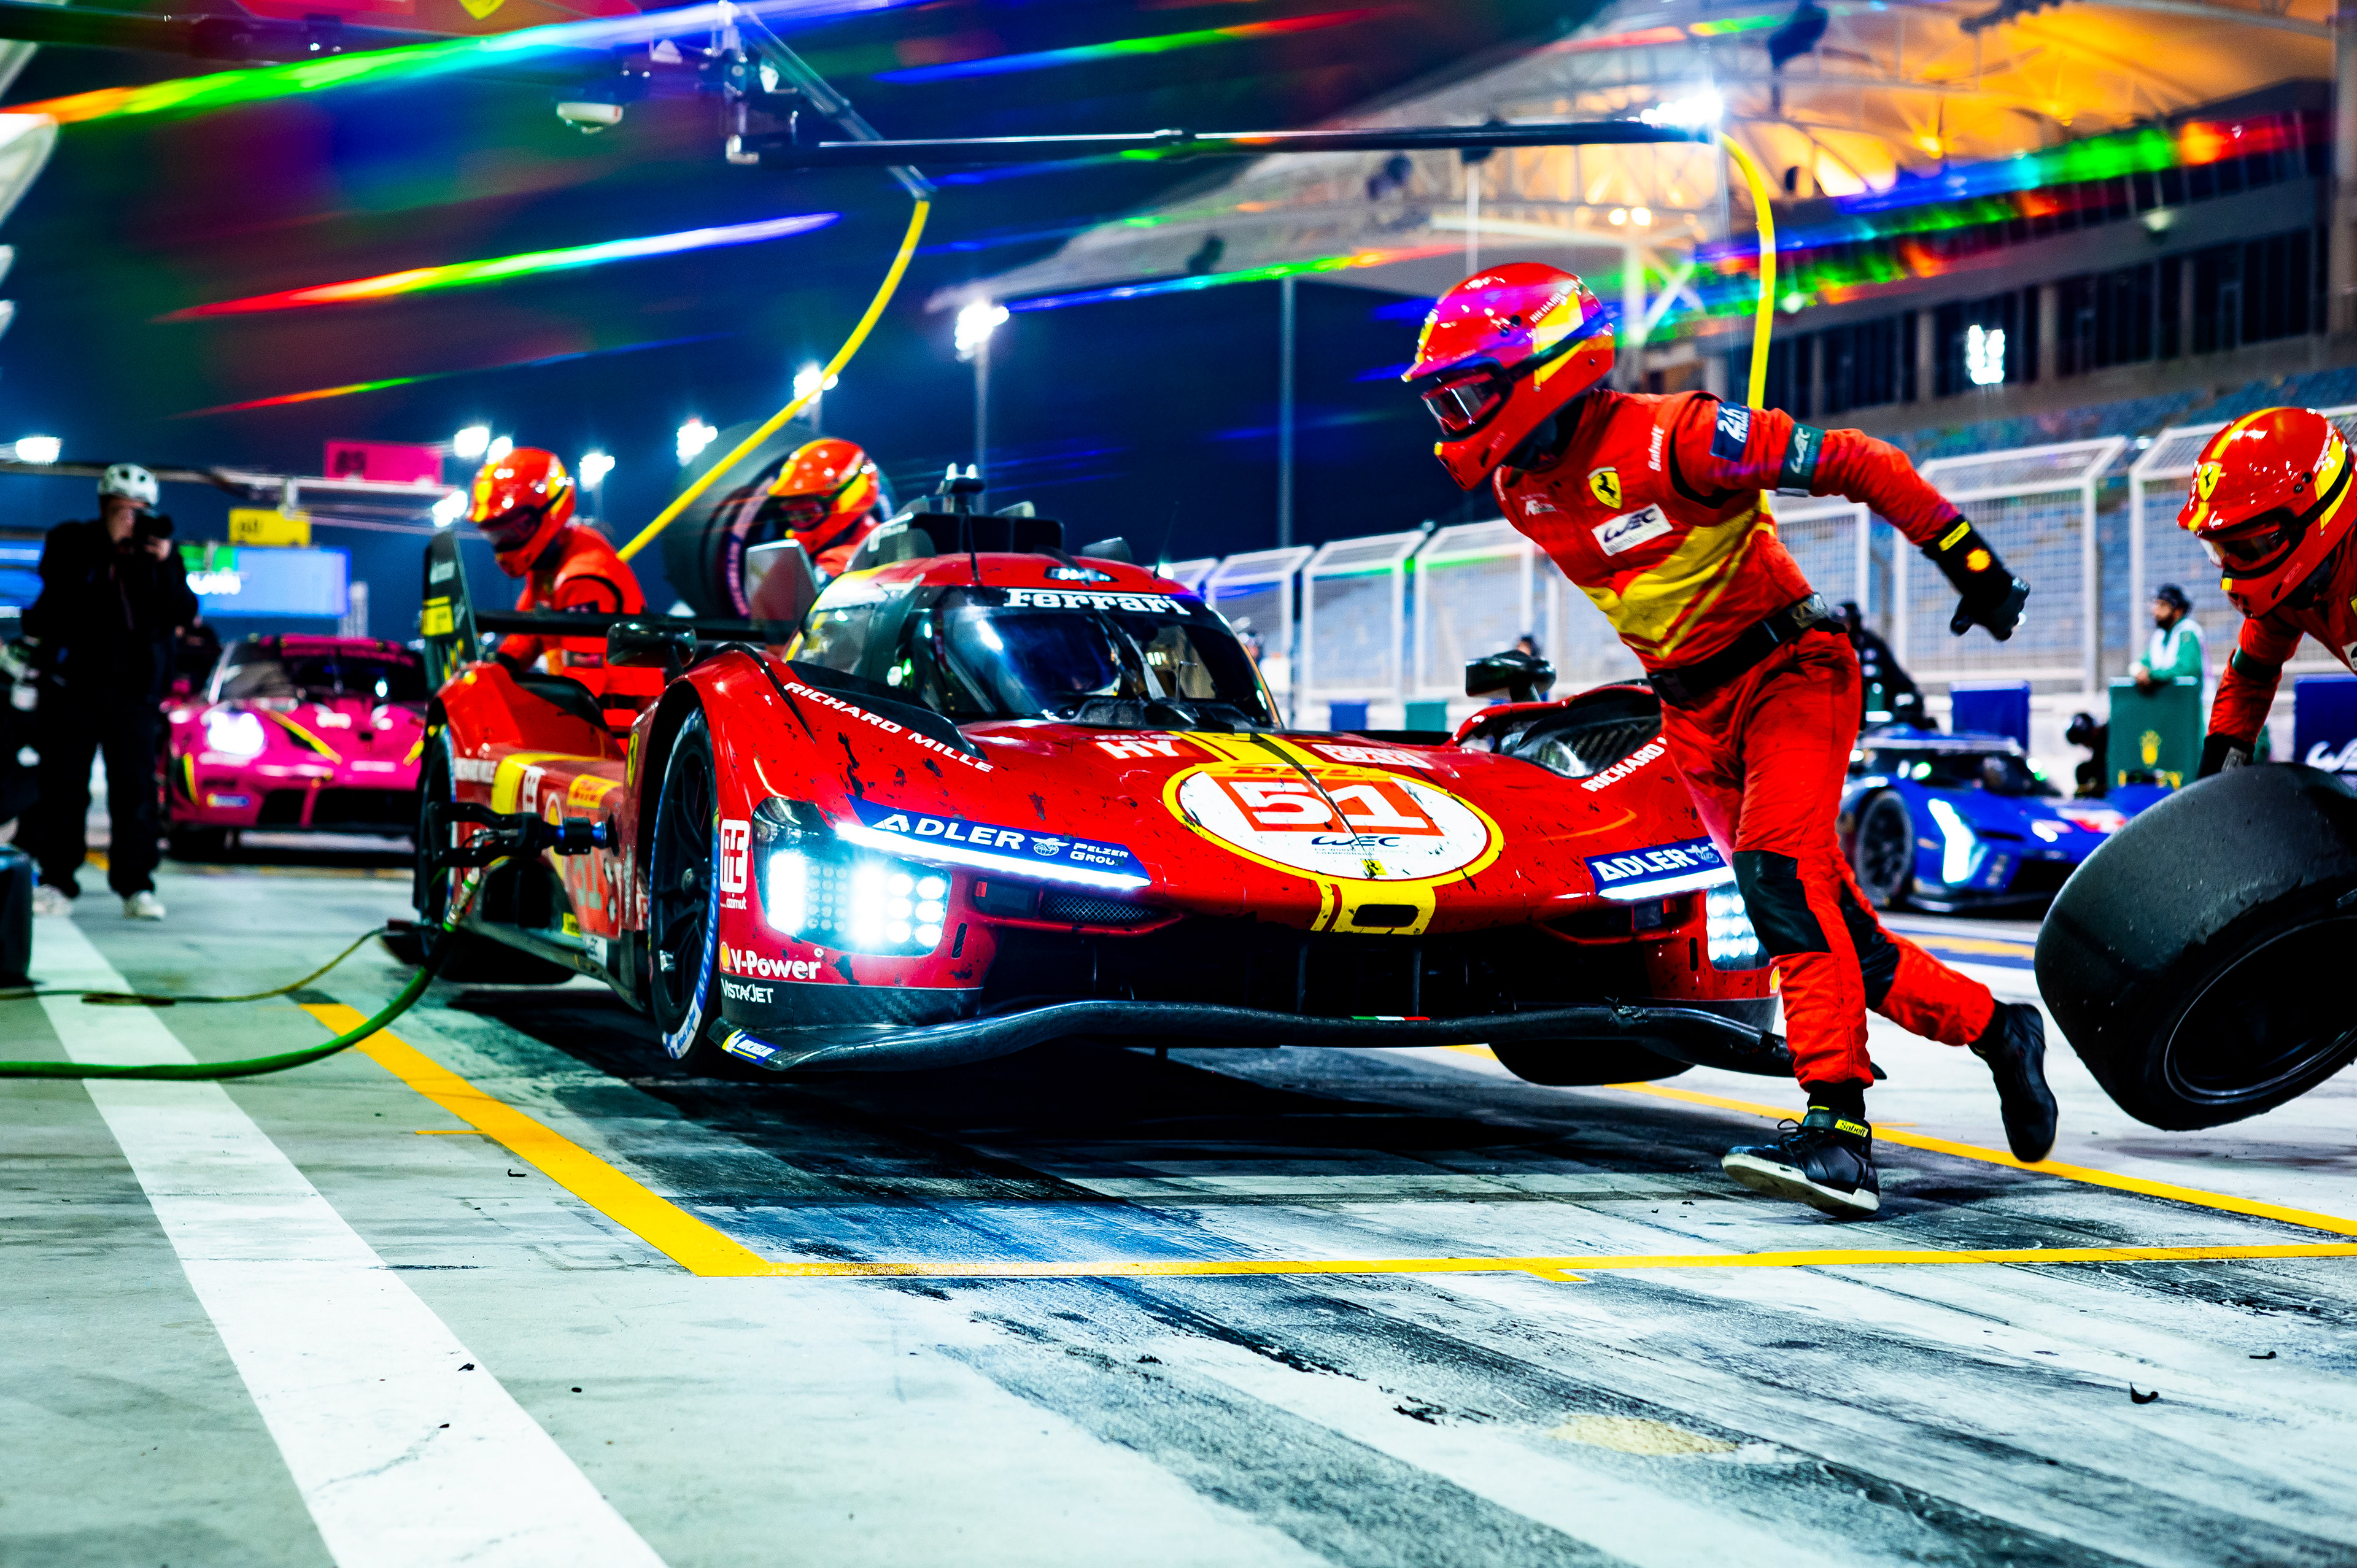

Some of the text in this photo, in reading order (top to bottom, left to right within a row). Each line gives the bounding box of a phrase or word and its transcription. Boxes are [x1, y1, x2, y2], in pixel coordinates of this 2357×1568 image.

[1603, 508, 1657, 543] WEC
[1003, 588, 1191, 616] Ferrari
[784, 682, 994, 773] RICHARD MILLE
[1096, 740, 1180, 760] HY
[1581, 743, 1665, 792] RICHARD
[1228, 781, 1430, 828] 51
[872, 813, 1026, 850] ADLER
[1311, 835, 1401, 848] WEC
[1070, 851, 1120, 866] GROU
[1073, 843, 1129, 858] PELZER
[1592, 849, 1698, 881] ADLER
[730, 949, 821, 979] V-Power
